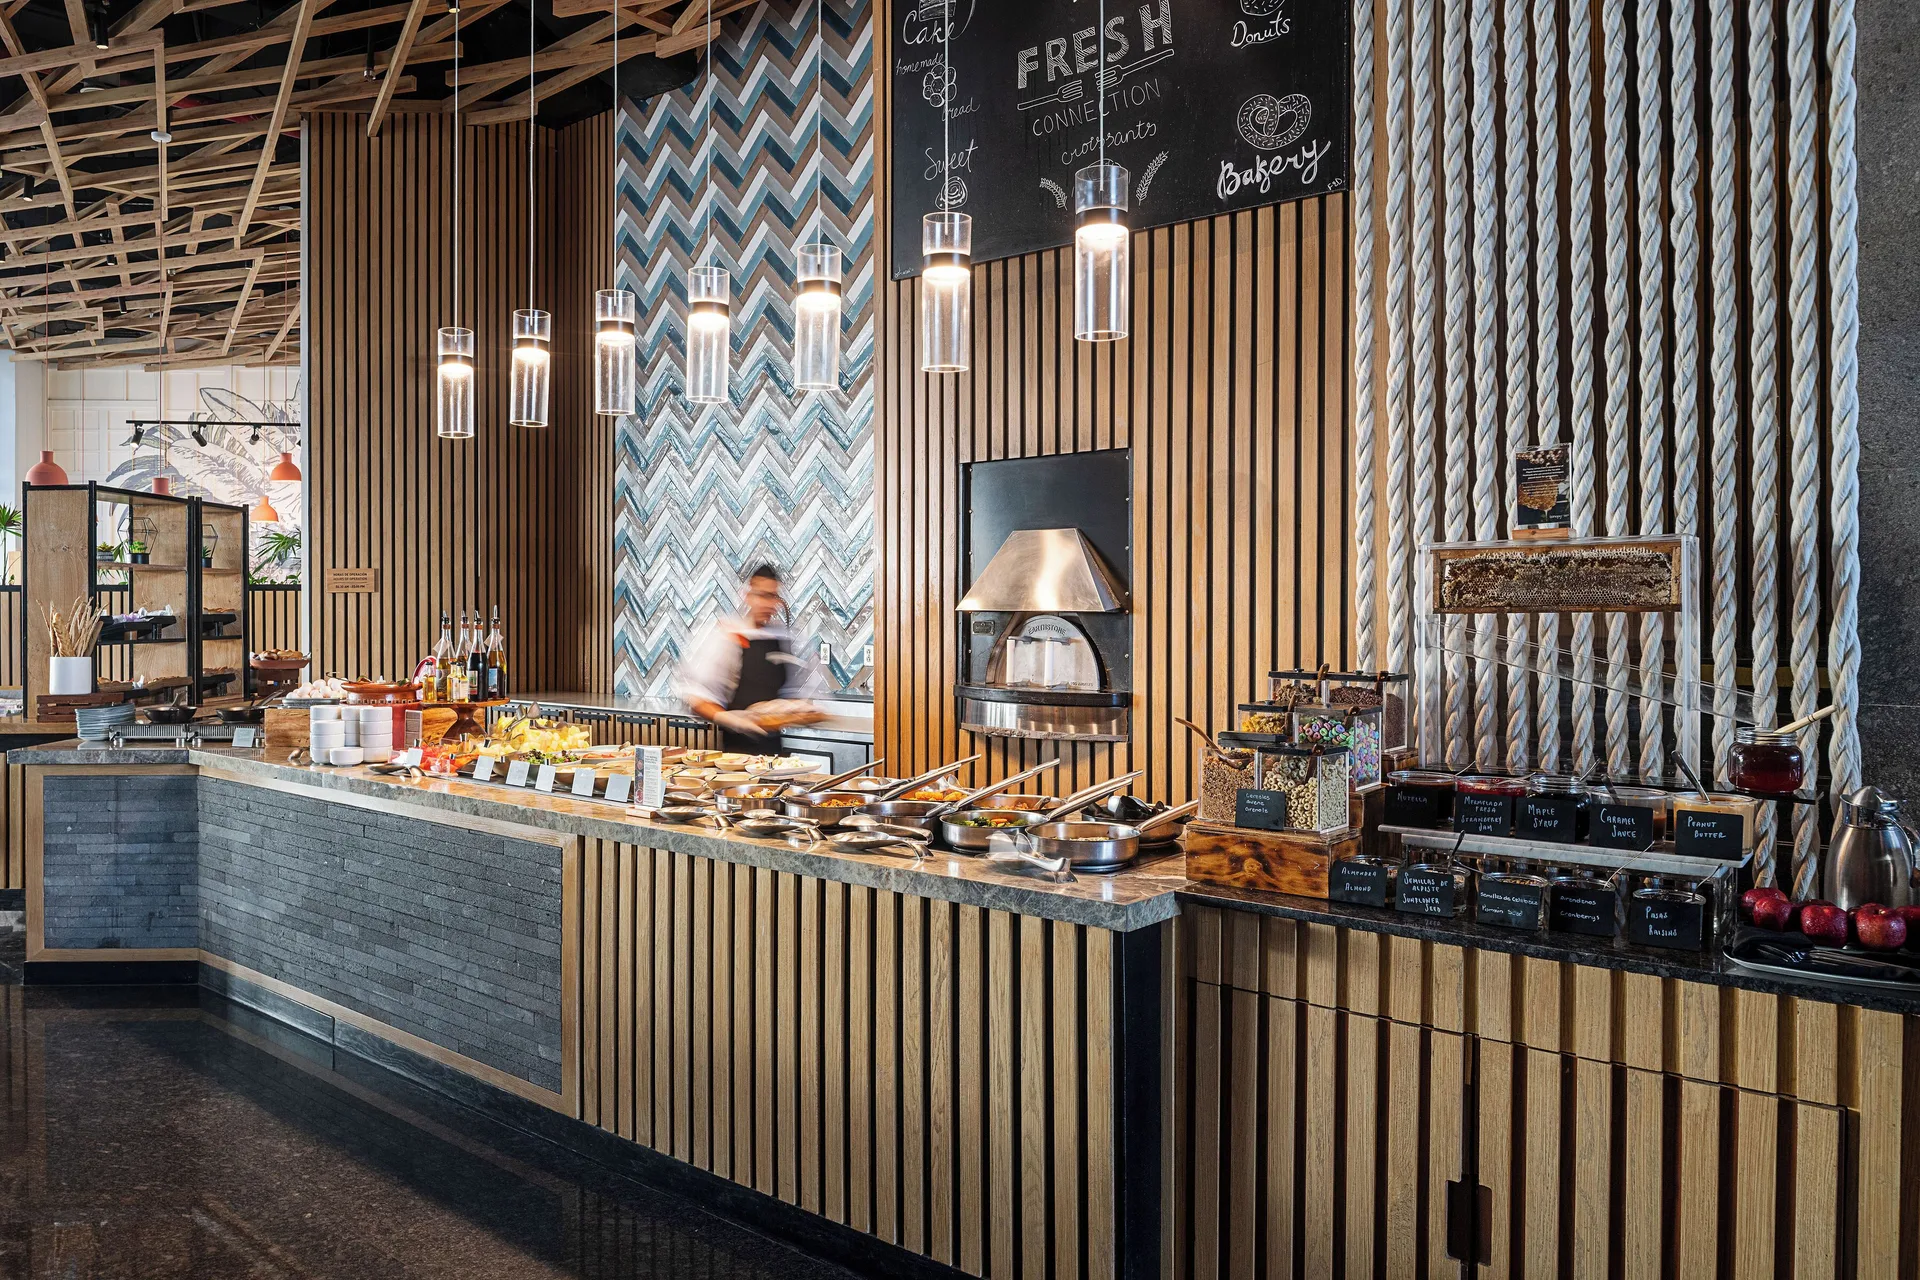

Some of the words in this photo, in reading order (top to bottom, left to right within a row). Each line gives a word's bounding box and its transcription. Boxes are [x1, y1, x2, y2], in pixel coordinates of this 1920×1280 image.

[903, 10, 955, 45] Cake
[1017, 0, 1173, 89] FRESH
[1230, 10, 1291, 47] Donuts
[896, 53, 945, 76] homemade
[1032, 78, 1161, 136] CONNECTION
[924, 139, 979, 181] Sweet
[1061, 120, 1157, 165] croissants
[1217, 139, 1331, 200] Bakery
